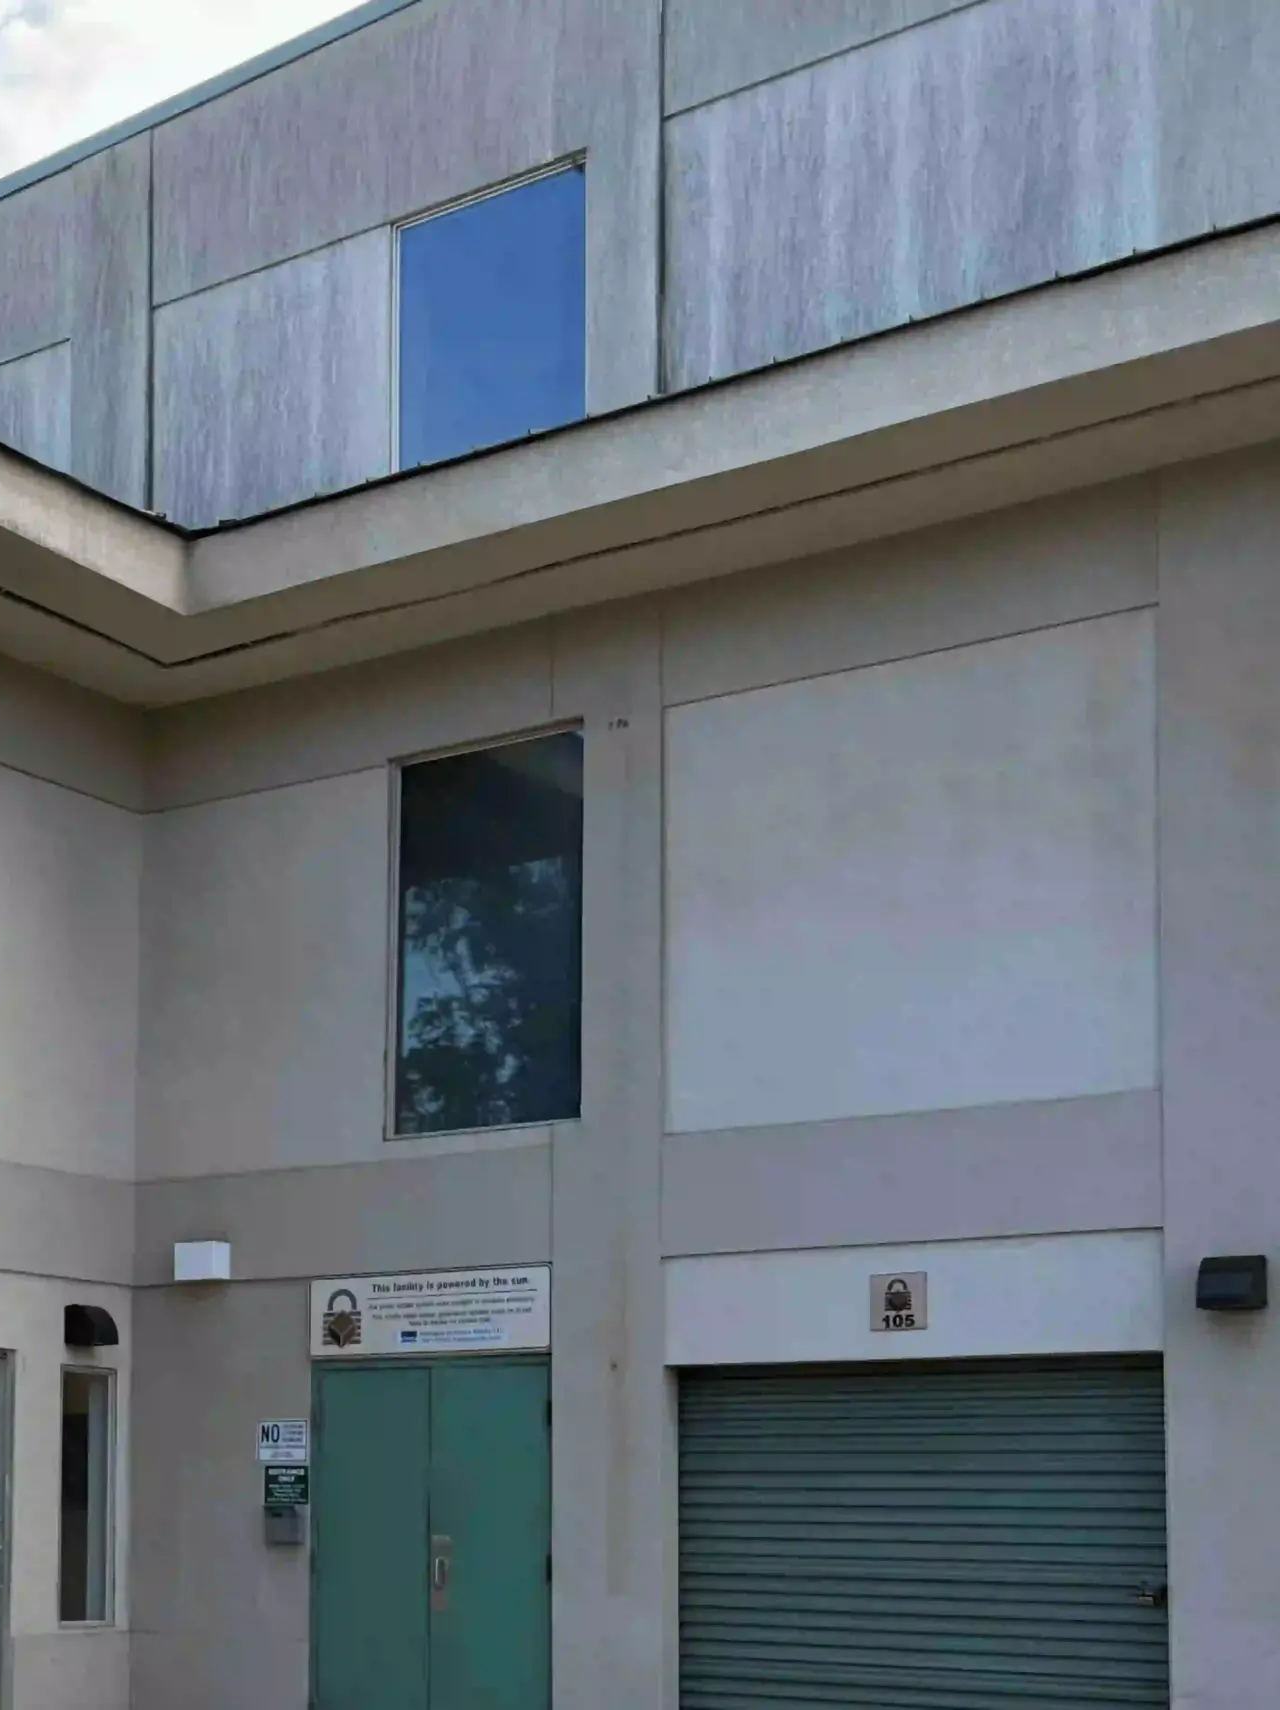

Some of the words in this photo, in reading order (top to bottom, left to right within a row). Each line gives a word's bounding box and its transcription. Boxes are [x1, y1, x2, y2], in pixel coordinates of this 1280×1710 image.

[372, 1283, 391, 1293] This
[426, 1280, 434, 1290] is
[437, 1279, 476, 1291] powered
[478, 1277, 490, 1289] by
[492, 1276, 509, 1287] the
[882, 1314, 916, 1330] 105
[261, 1423, 280, 1443] NO
